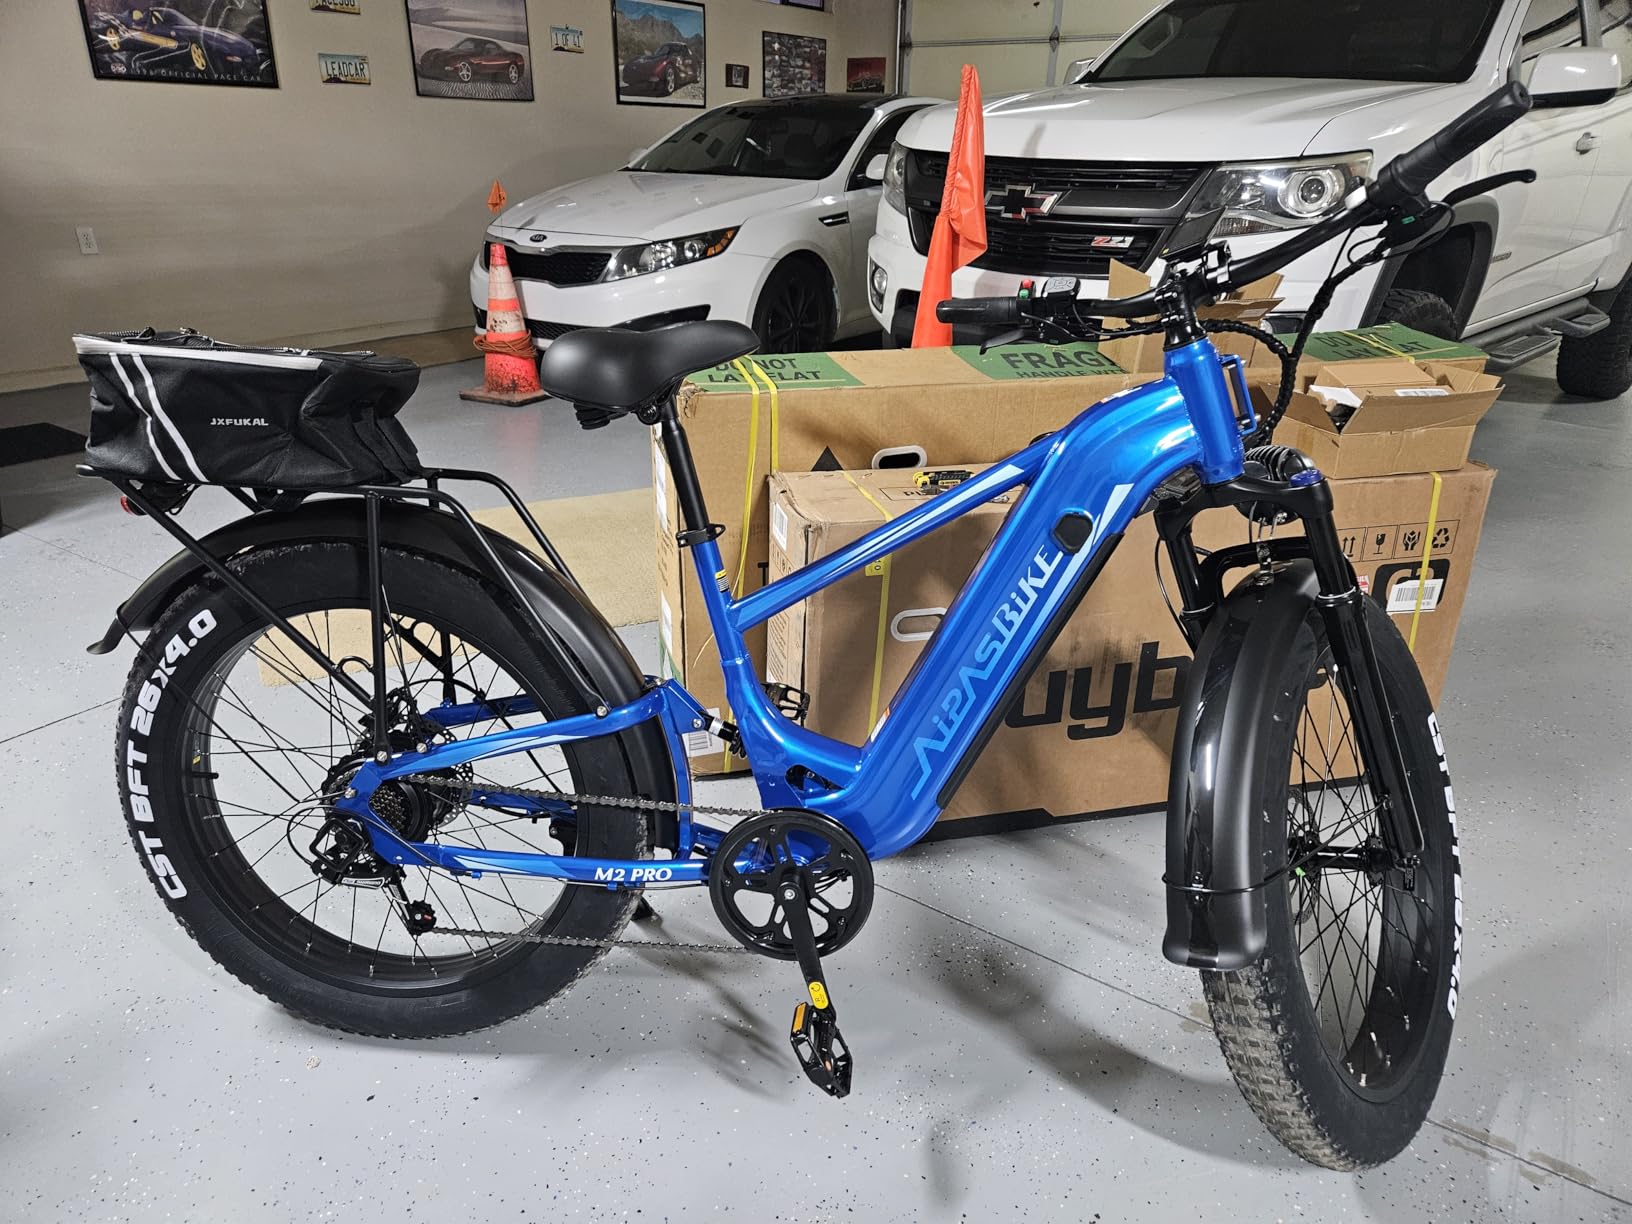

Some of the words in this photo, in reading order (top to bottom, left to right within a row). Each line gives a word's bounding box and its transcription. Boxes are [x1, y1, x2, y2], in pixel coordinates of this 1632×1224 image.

[324, 60, 367, 78] LEADCAR
[1000, 350, 1106, 370] FRAG
[210, 417, 269, 426] JXFUKAL
[126, 738, 154, 823] BFT
[138, 829, 188, 900] CST
[593, 867, 626, 882] M2
[630, 867, 673, 882] PRO
